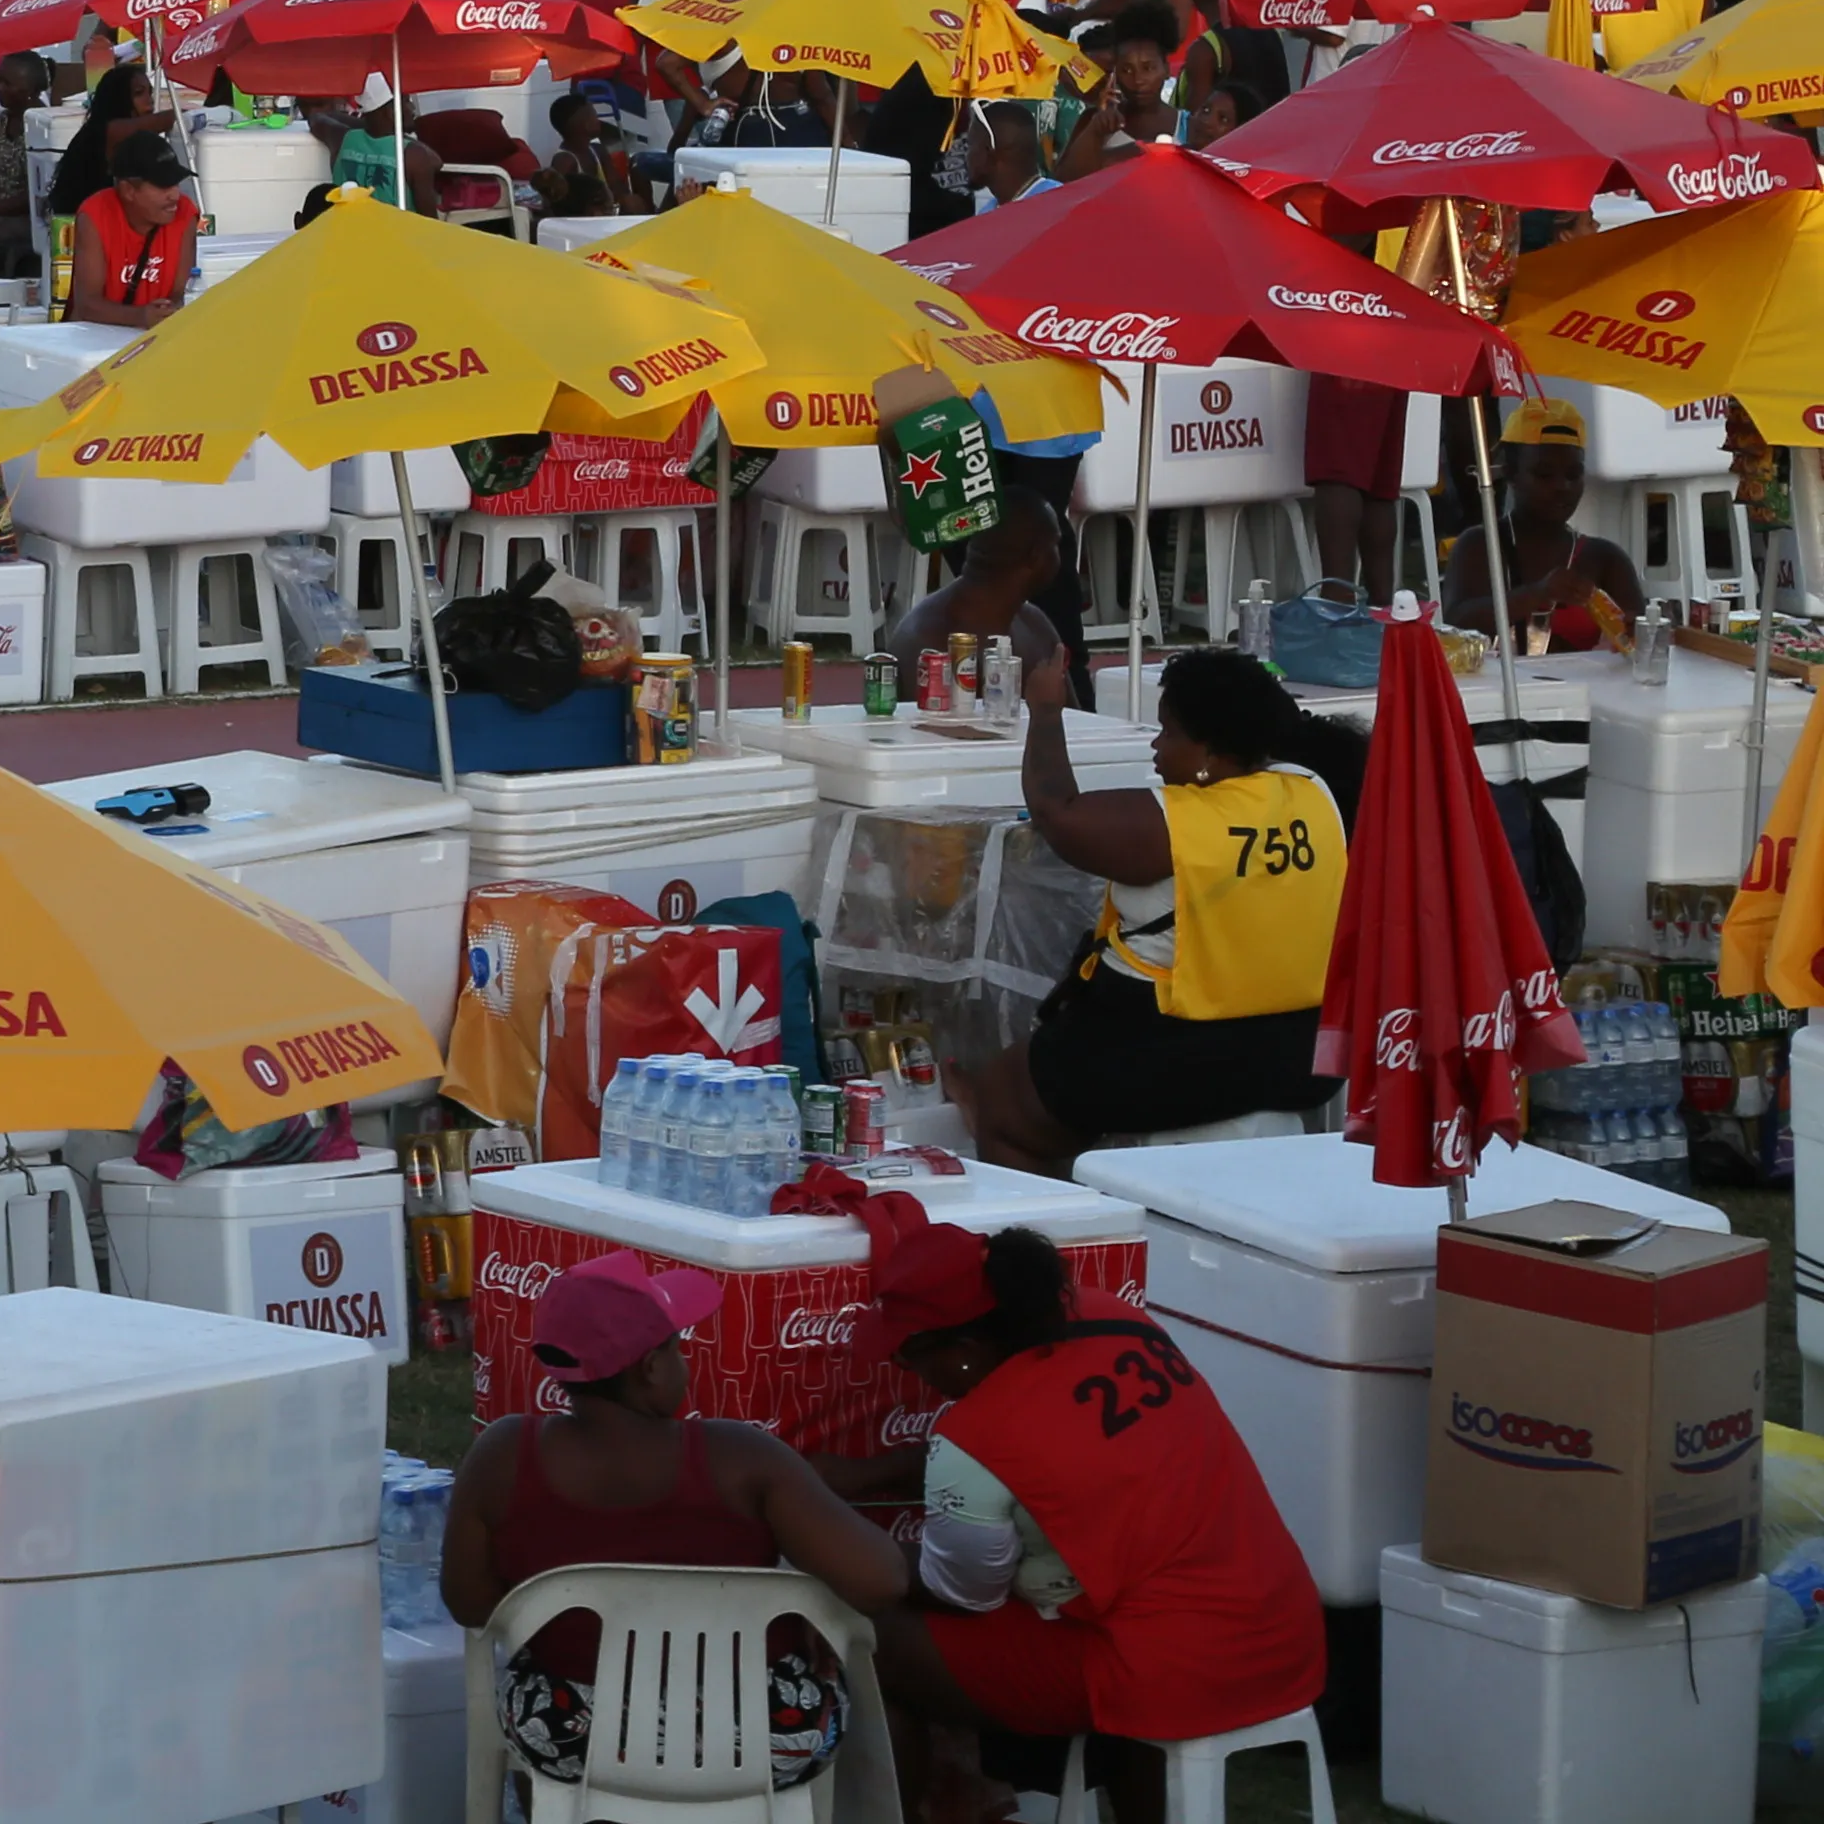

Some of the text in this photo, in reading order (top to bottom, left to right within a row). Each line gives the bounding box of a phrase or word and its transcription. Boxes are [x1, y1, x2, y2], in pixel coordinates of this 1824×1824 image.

[457, 0, 543, 31] Coca-Cola
[800, 45, 872, 71] DEVASSA
[1372, 131, 1528, 164] Coca-Cola
[1668, 152, 1774, 205] Coca-Cola
[1267, 284, 1395, 319] Coca-Cola
[1018, 305, 1180, 360] Coca-Cola
[1550, 310, 1707, 370] DEVASSA
[310, 346, 488, 406] DEVASSA
[635, 338, 728, 387] DEVASSA
[107, 433, 204, 463] DEVASSA
[1171, 417, 1265, 454] DEVASSA
[573, 458, 631, 481] Coca-Cola
[958, 421, 996, 502] Hein
[1227, 818, 1316, 877] 758
[276, 1019, 403, 1084] DEVASSA
[475, 1148, 528, 1167] AMSTEL
[1073, 1333, 1196, 1439] 238
